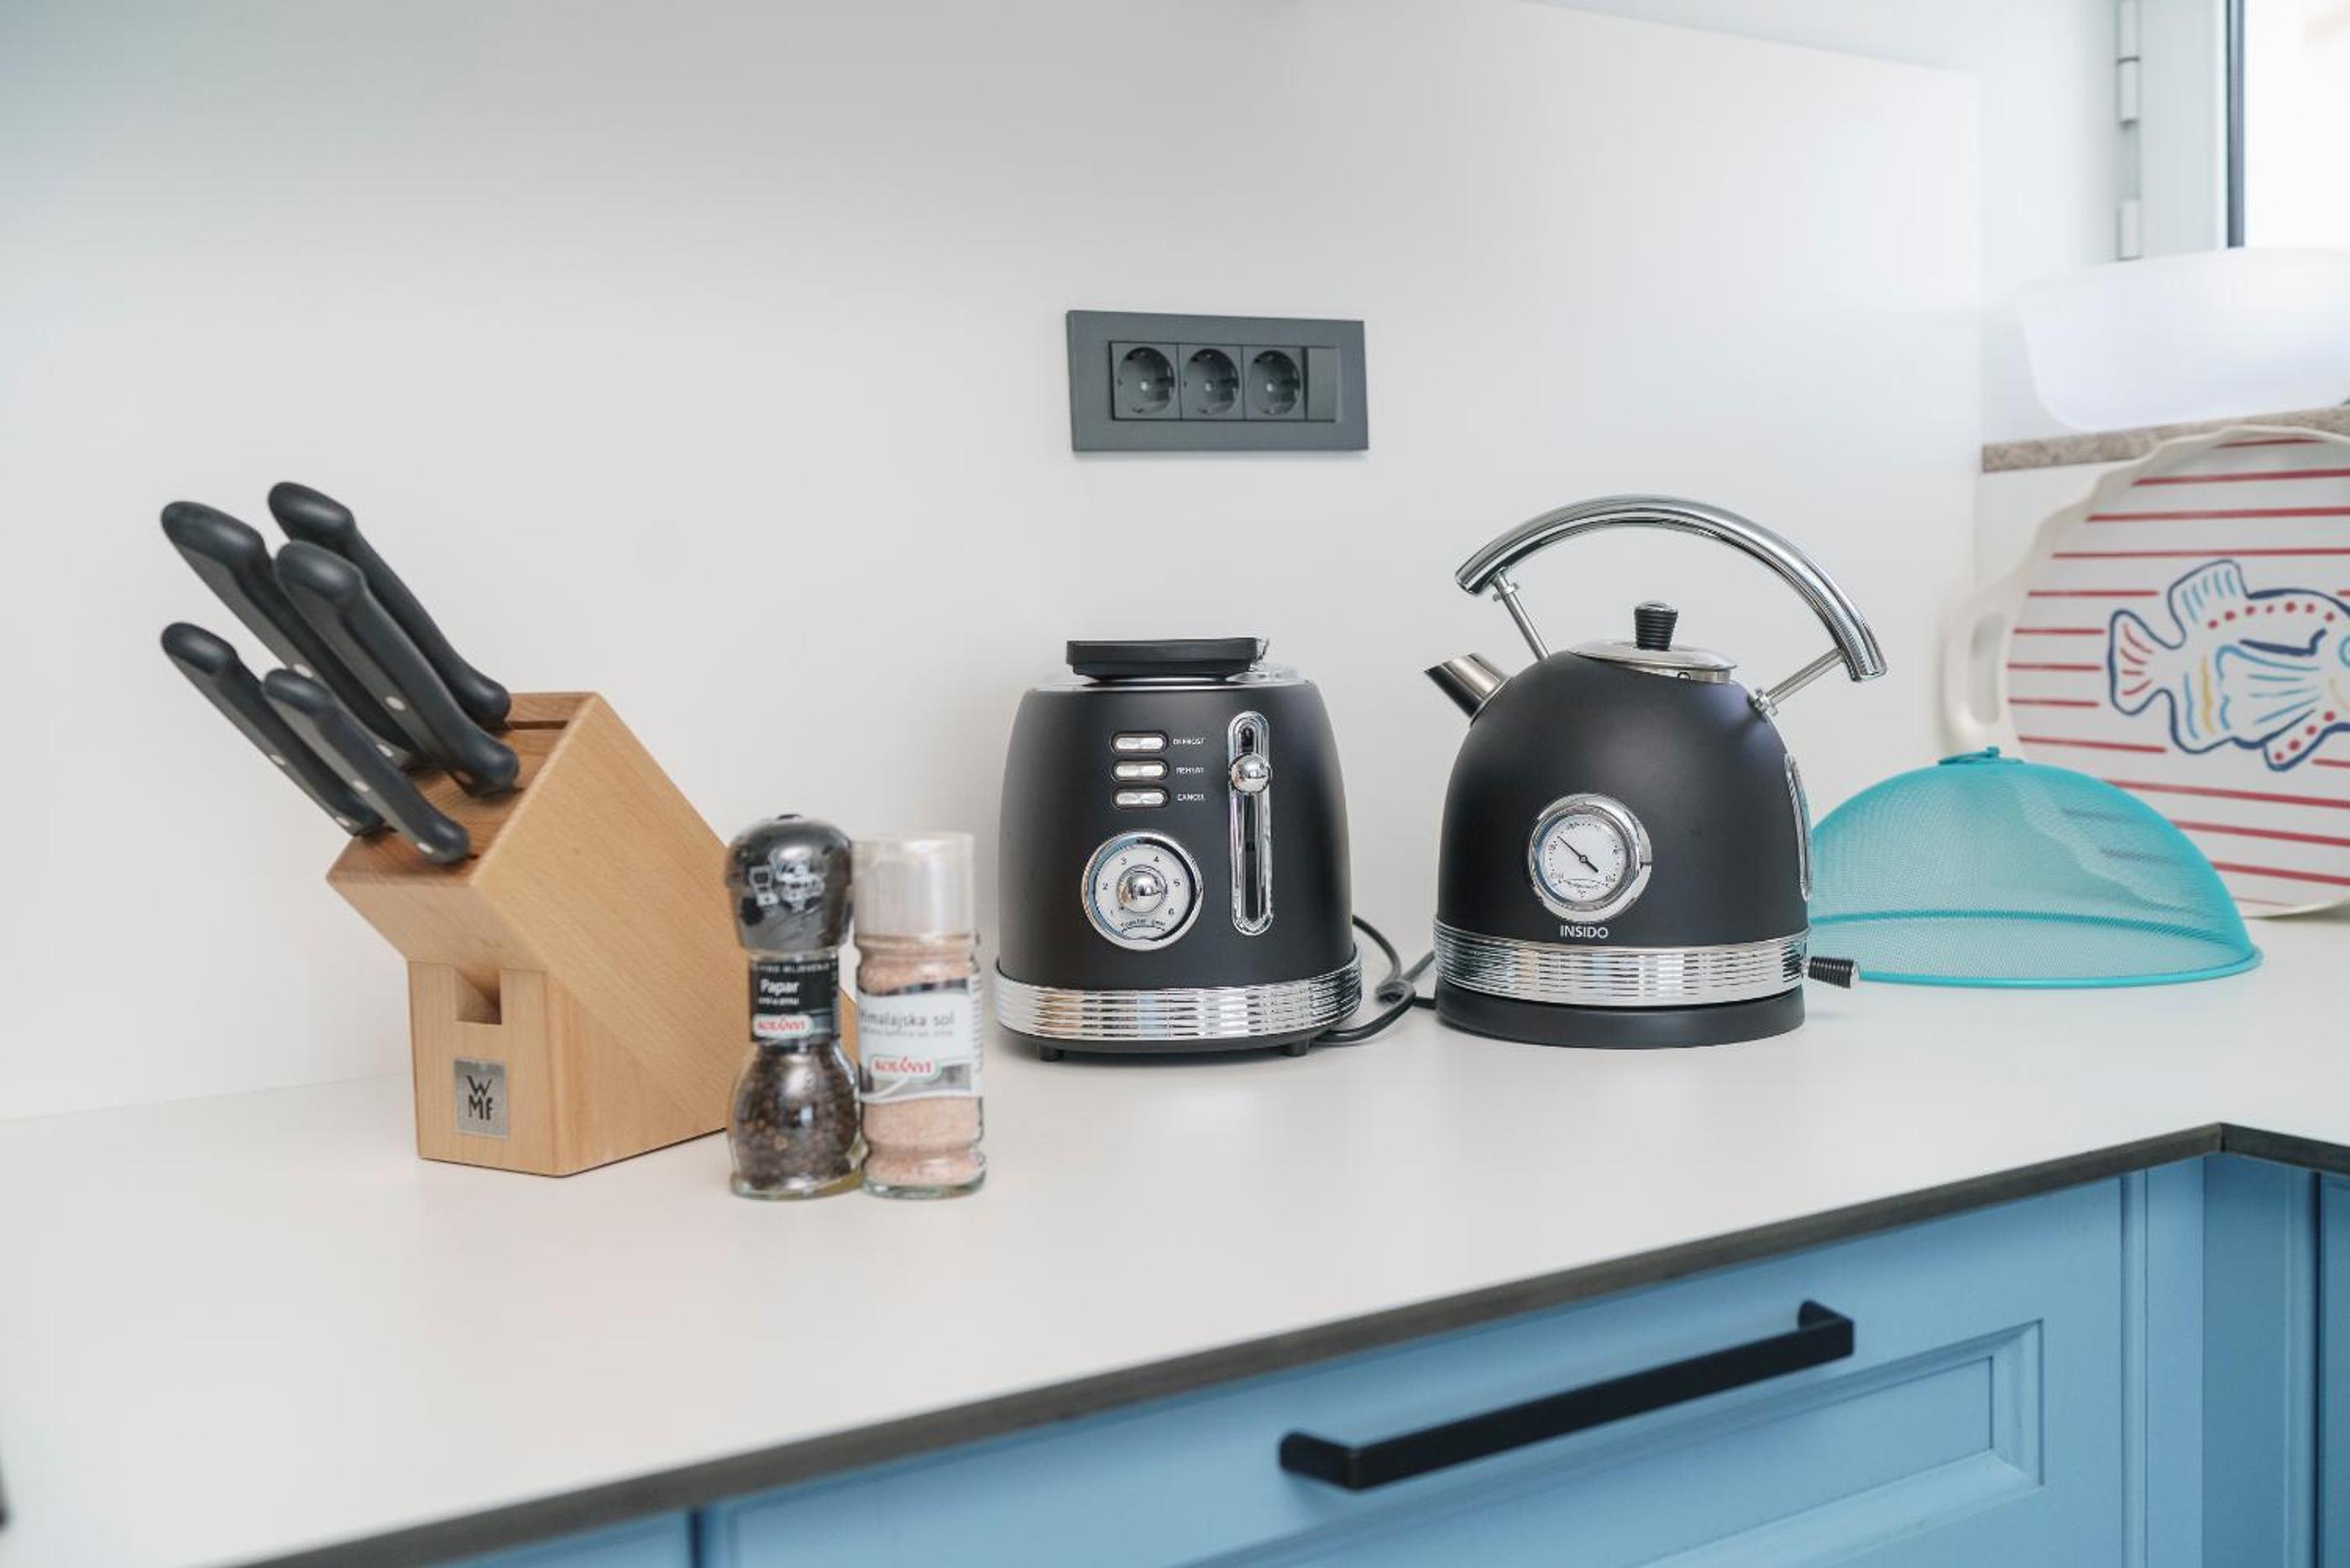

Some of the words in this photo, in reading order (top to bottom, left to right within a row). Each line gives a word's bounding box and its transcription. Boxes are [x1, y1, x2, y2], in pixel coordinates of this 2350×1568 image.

[1102, 882, 1109, 891] 2
[1173, 879, 1180, 887] 5
[1168, 907, 1175, 916] 6
[1559, 925, 1609, 939] INSIDO
